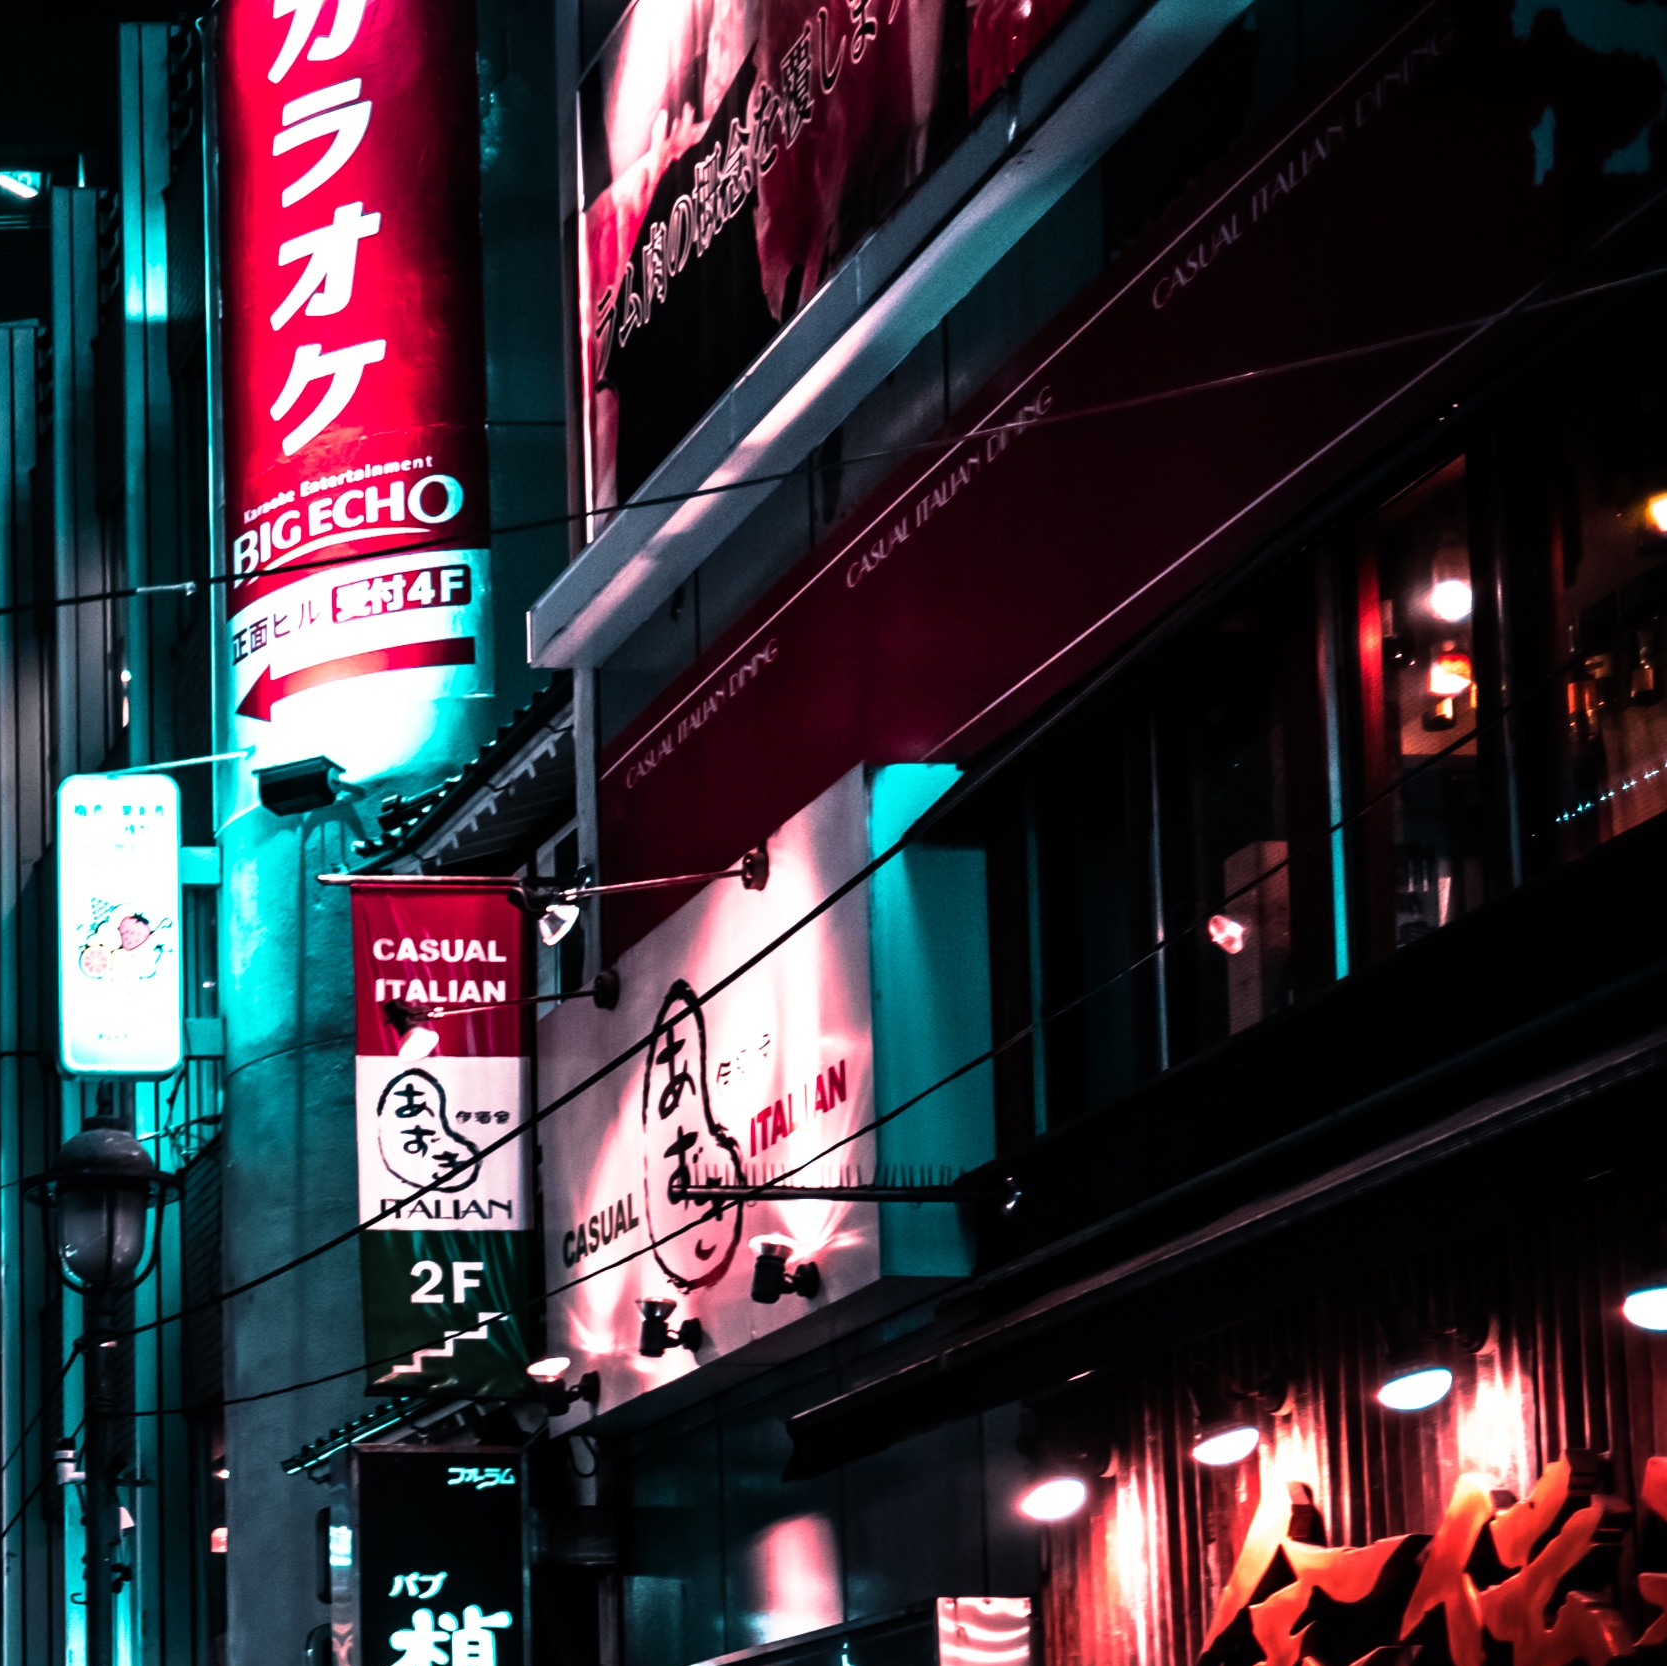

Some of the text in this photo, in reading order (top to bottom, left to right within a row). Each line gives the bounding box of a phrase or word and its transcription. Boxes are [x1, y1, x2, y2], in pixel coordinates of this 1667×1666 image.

[1149, 19, 1456, 312] CASUAL ITALIAN DINING
[268, 0, 387, 457] カラオケ
[244, 454, 434, 524] Karaoke Entertainment
[845, 386, 1054, 589] CASUAL ITALIAN DINING
[233, 473, 465, 591] BIG ECHO
[623, 638, 779, 788] CASUAL ITALIAN DINING
[373, 937, 507, 963] CASUAL
[375, 979, 507, 1003] ITALIAN
[378, 1196, 514, 1222] ITALIAN
[563, 1193, 640, 1268] CASUAL
[409, 1261, 485, 1305] 2F
[388, 1572, 449, 1599] パブ
